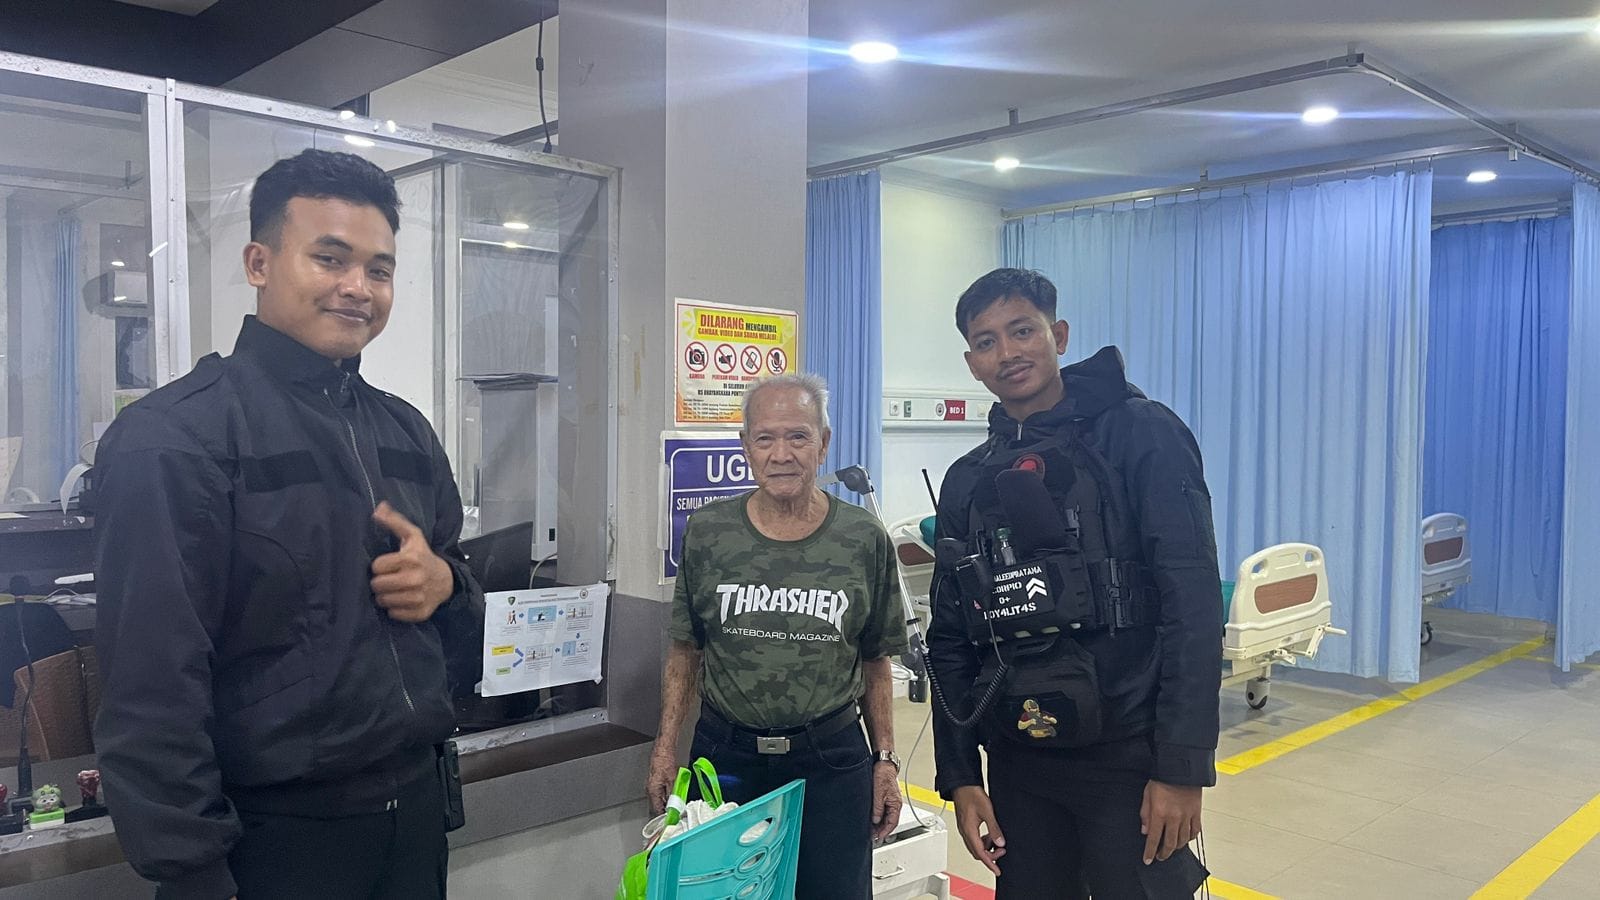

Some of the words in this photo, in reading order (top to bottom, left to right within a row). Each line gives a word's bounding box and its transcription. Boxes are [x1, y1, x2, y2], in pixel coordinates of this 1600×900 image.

[701, 314, 744, 330] DILARANG
[745, 323, 777, 333] MENGAMBIL
[676, 497, 702, 510] SEMUA
[716, 583, 850, 633] THRASHER
[721, 626, 787, 640] SKATEBOARD
[789, 632, 841, 642] MAGAZINE
